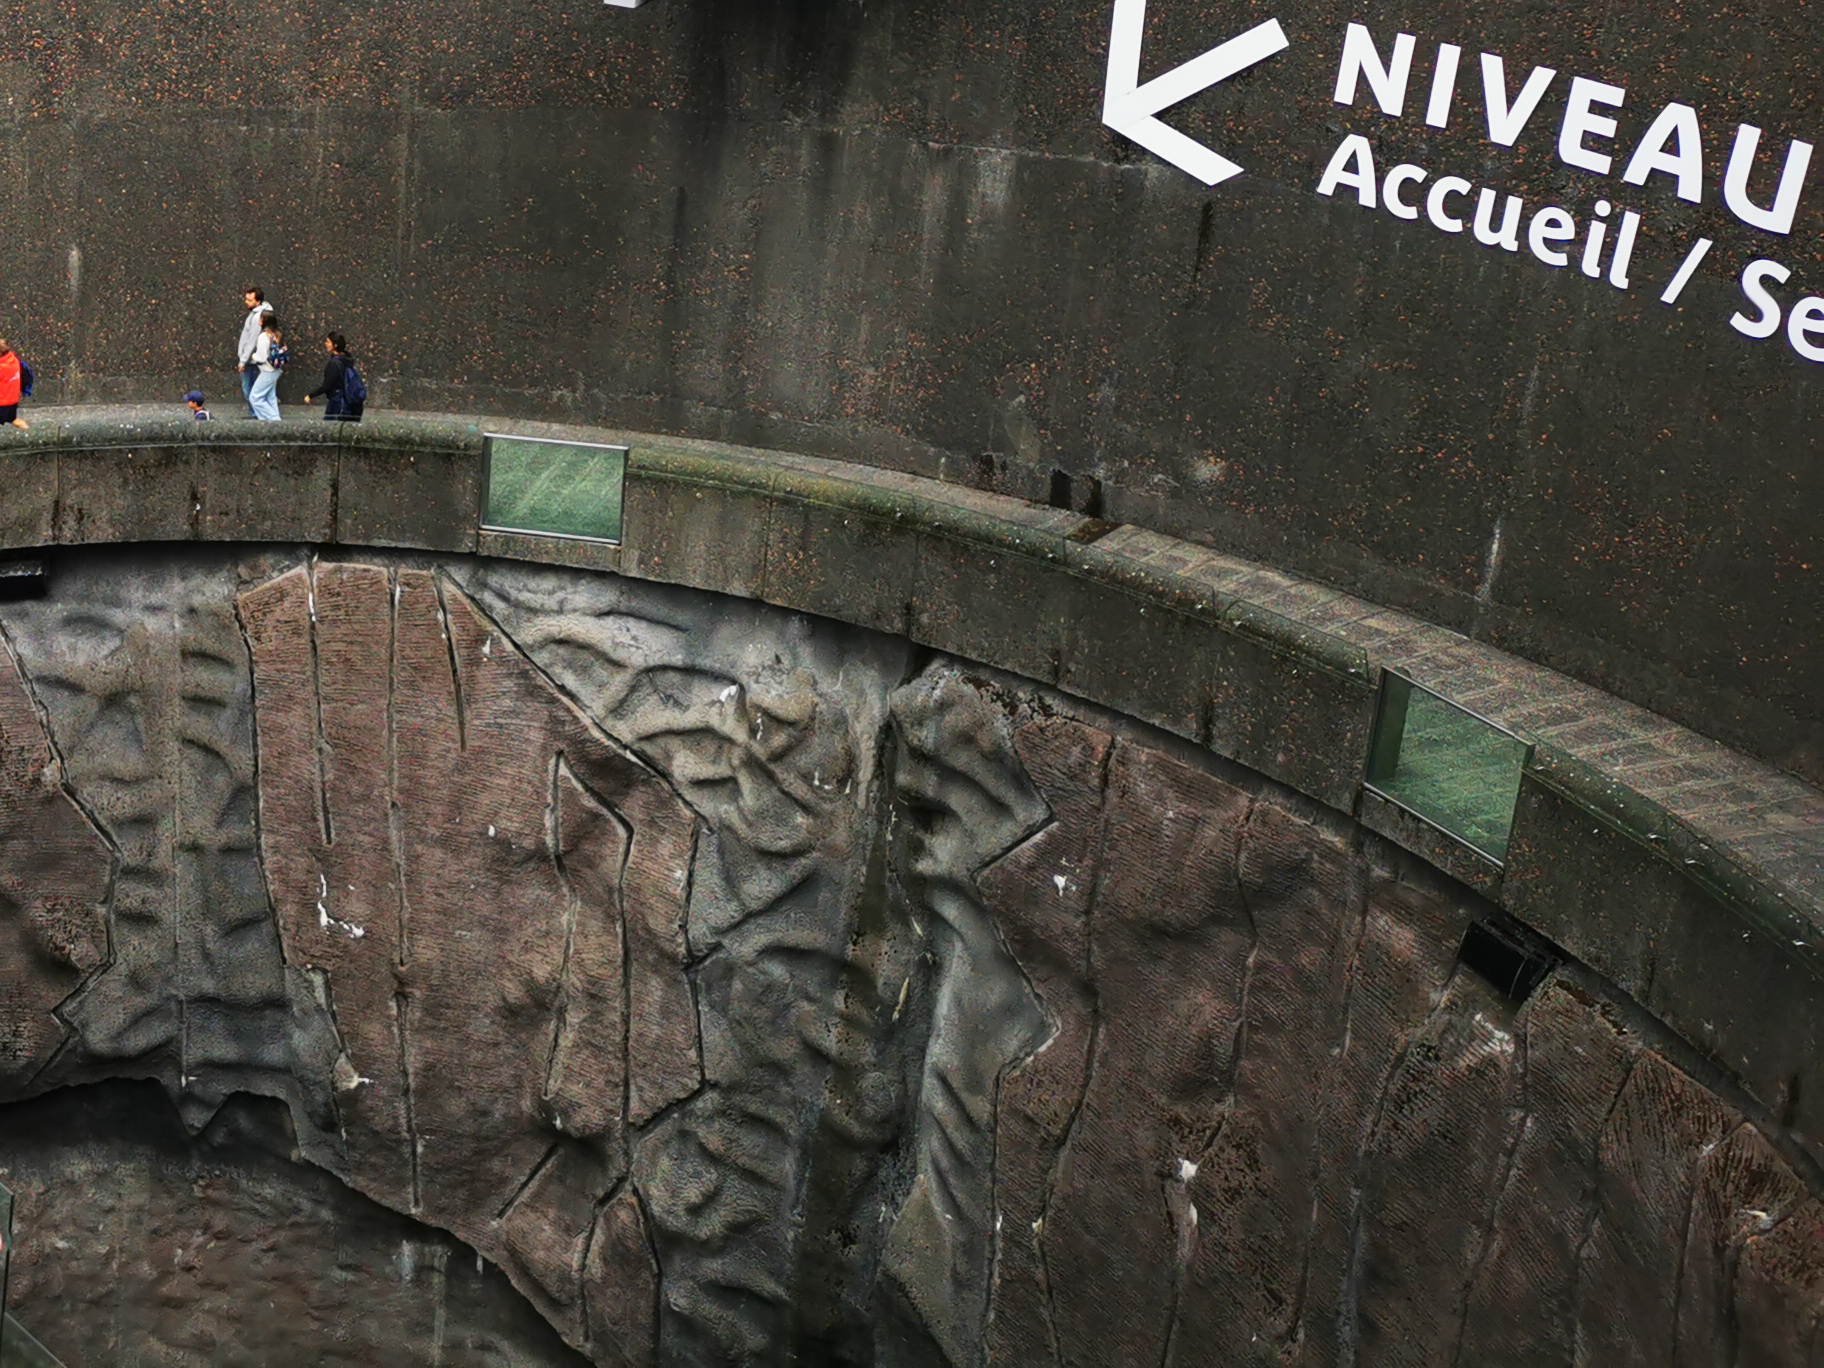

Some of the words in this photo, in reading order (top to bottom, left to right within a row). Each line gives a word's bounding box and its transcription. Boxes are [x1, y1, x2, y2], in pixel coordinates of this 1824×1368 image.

[1333, 22, 1814, 235] NIVEAU
[1316, 133, 1641, 289] Accueil
[1660, 237, 1713, 304] /
[1729, 259, 1824, 362] Se
